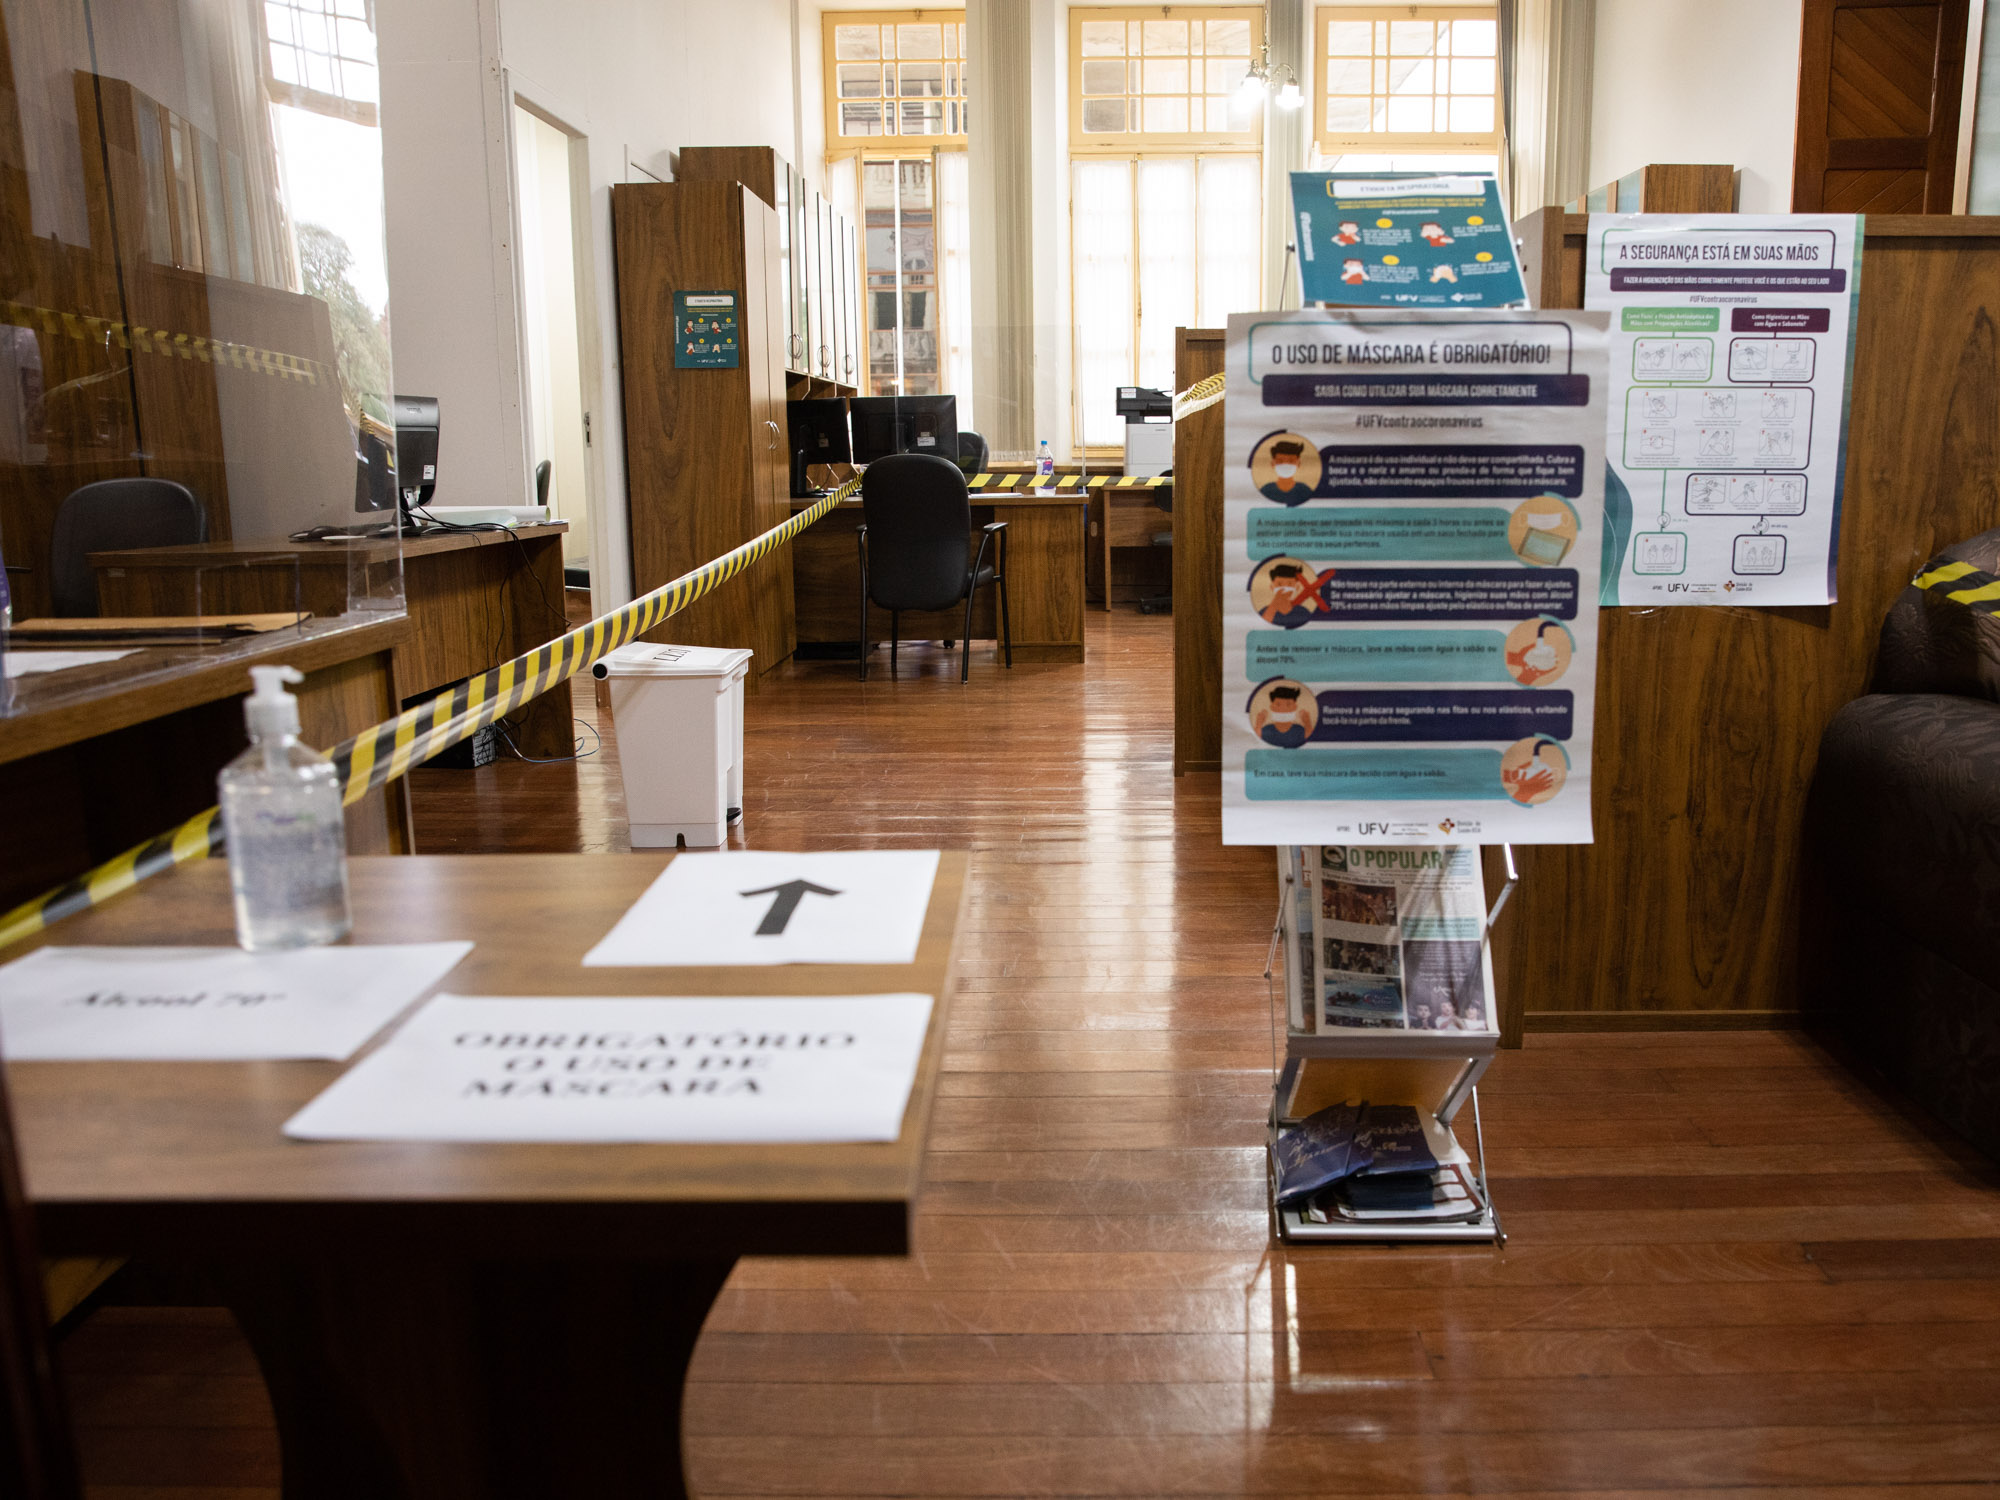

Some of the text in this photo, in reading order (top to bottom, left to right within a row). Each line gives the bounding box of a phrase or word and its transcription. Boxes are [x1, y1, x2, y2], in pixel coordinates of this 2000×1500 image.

[1620, 242, 1819, 262] A SEGURANÇA ESTÁ EM SUAS MÃOS
[1272, 340, 1550, 364] O USO DE MÁSCARA É OBRIGATÓRIO!
[1315, 382, 1538, 397] SAIBA COMO UTILIZAR SUA MÁSCARA CORRETAMENTE
[1328, 466, 1348, 474] boca
[1368, 466, 1387, 474] nariz
[1442, 466, 1476, 476] prenda-o
[1479, 466, 1489, 474] de
[1492, 466, 1514, 474] forma
[1518, 468, 1532, 476] que
[1536, 466, 1554, 476] fique
[1558, 466, 1574, 474] bem
[1330, 580, 1573, 588] Não toque na parte externa ou interna da máscara para fazer ajustes.
[1668, 584, 1689, 592] UFV
[1330, 591, 1340, 599] Se
[1342, 591, 1383, 599] necessário
[1384, 591, 1410, 599] ajustar
[1419, 591, 1453, 599] máscara,
[1454, 591, 1488, 599] higienize
[1490, 591, 1507, 599] suas
[1509, 591, 1529, 599] mãos
[1531, 591, 1548, 599] com
[1550, 591, 1573, 599] álcool
[1322, 706, 1353, 714] Remova
[1362, 706, 1394, 714] máscara
[1396, 706, 1434, 716] segurando
[1437, 706, 1450, 714] nas
[1452, 706, 1468, 714] fitas
[1470, 706, 1481, 714] ou
[1483, 706, 1496, 714] nos
[1499, 706, 1534, 714] elásticos,
[1536, 706, 1568, 714] evitando
[1358, 823, 1389, 835] UFV
[1350, 848, 1442, 869] O POPULAR
[454, 1030, 857, 1050] OBRIGATÓRIO
[505, 1055, 768, 1072] O USO DE
[461, 1078, 761, 1098] MÁSCARA
